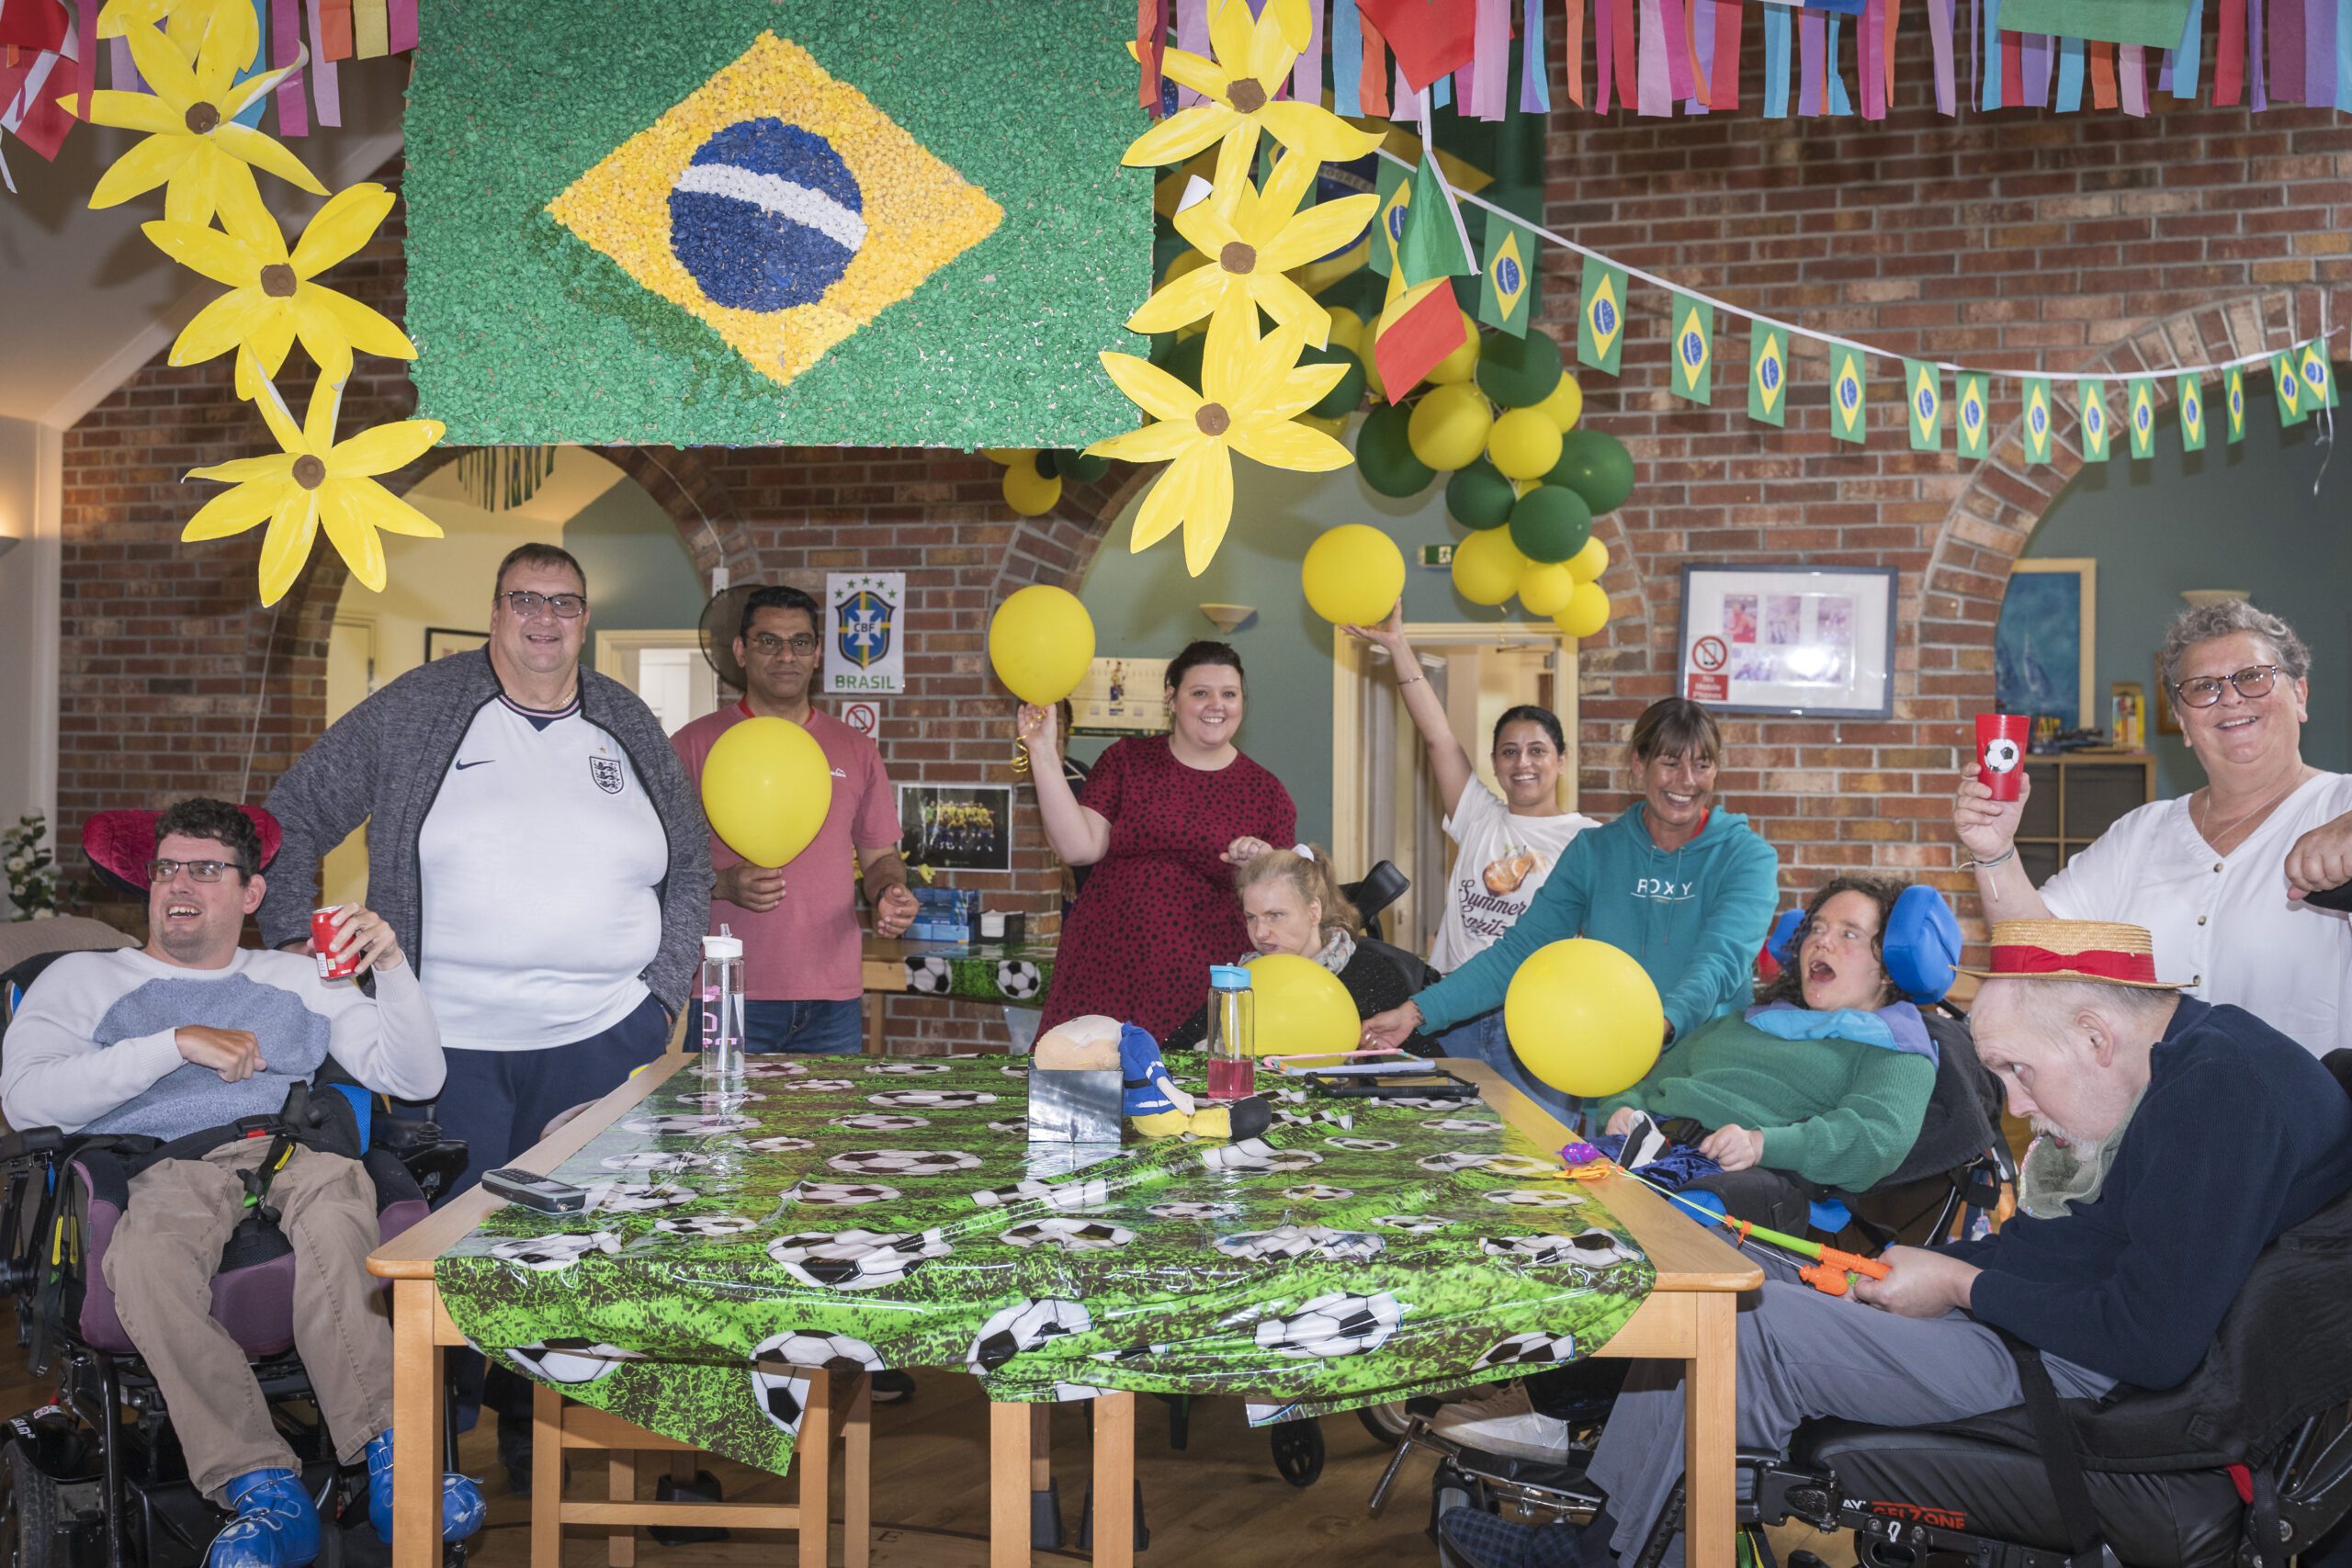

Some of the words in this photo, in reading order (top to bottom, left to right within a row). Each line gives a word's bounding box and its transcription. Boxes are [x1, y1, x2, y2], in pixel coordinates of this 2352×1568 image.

[854, 623, 876, 633] CBF
[835, 674, 896, 689] BRASIL
[1637, 878, 1693, 896] ROXY
[1458, 879, 1527, 916] Summer
[1842, 1498, 1861, 1510] AY
